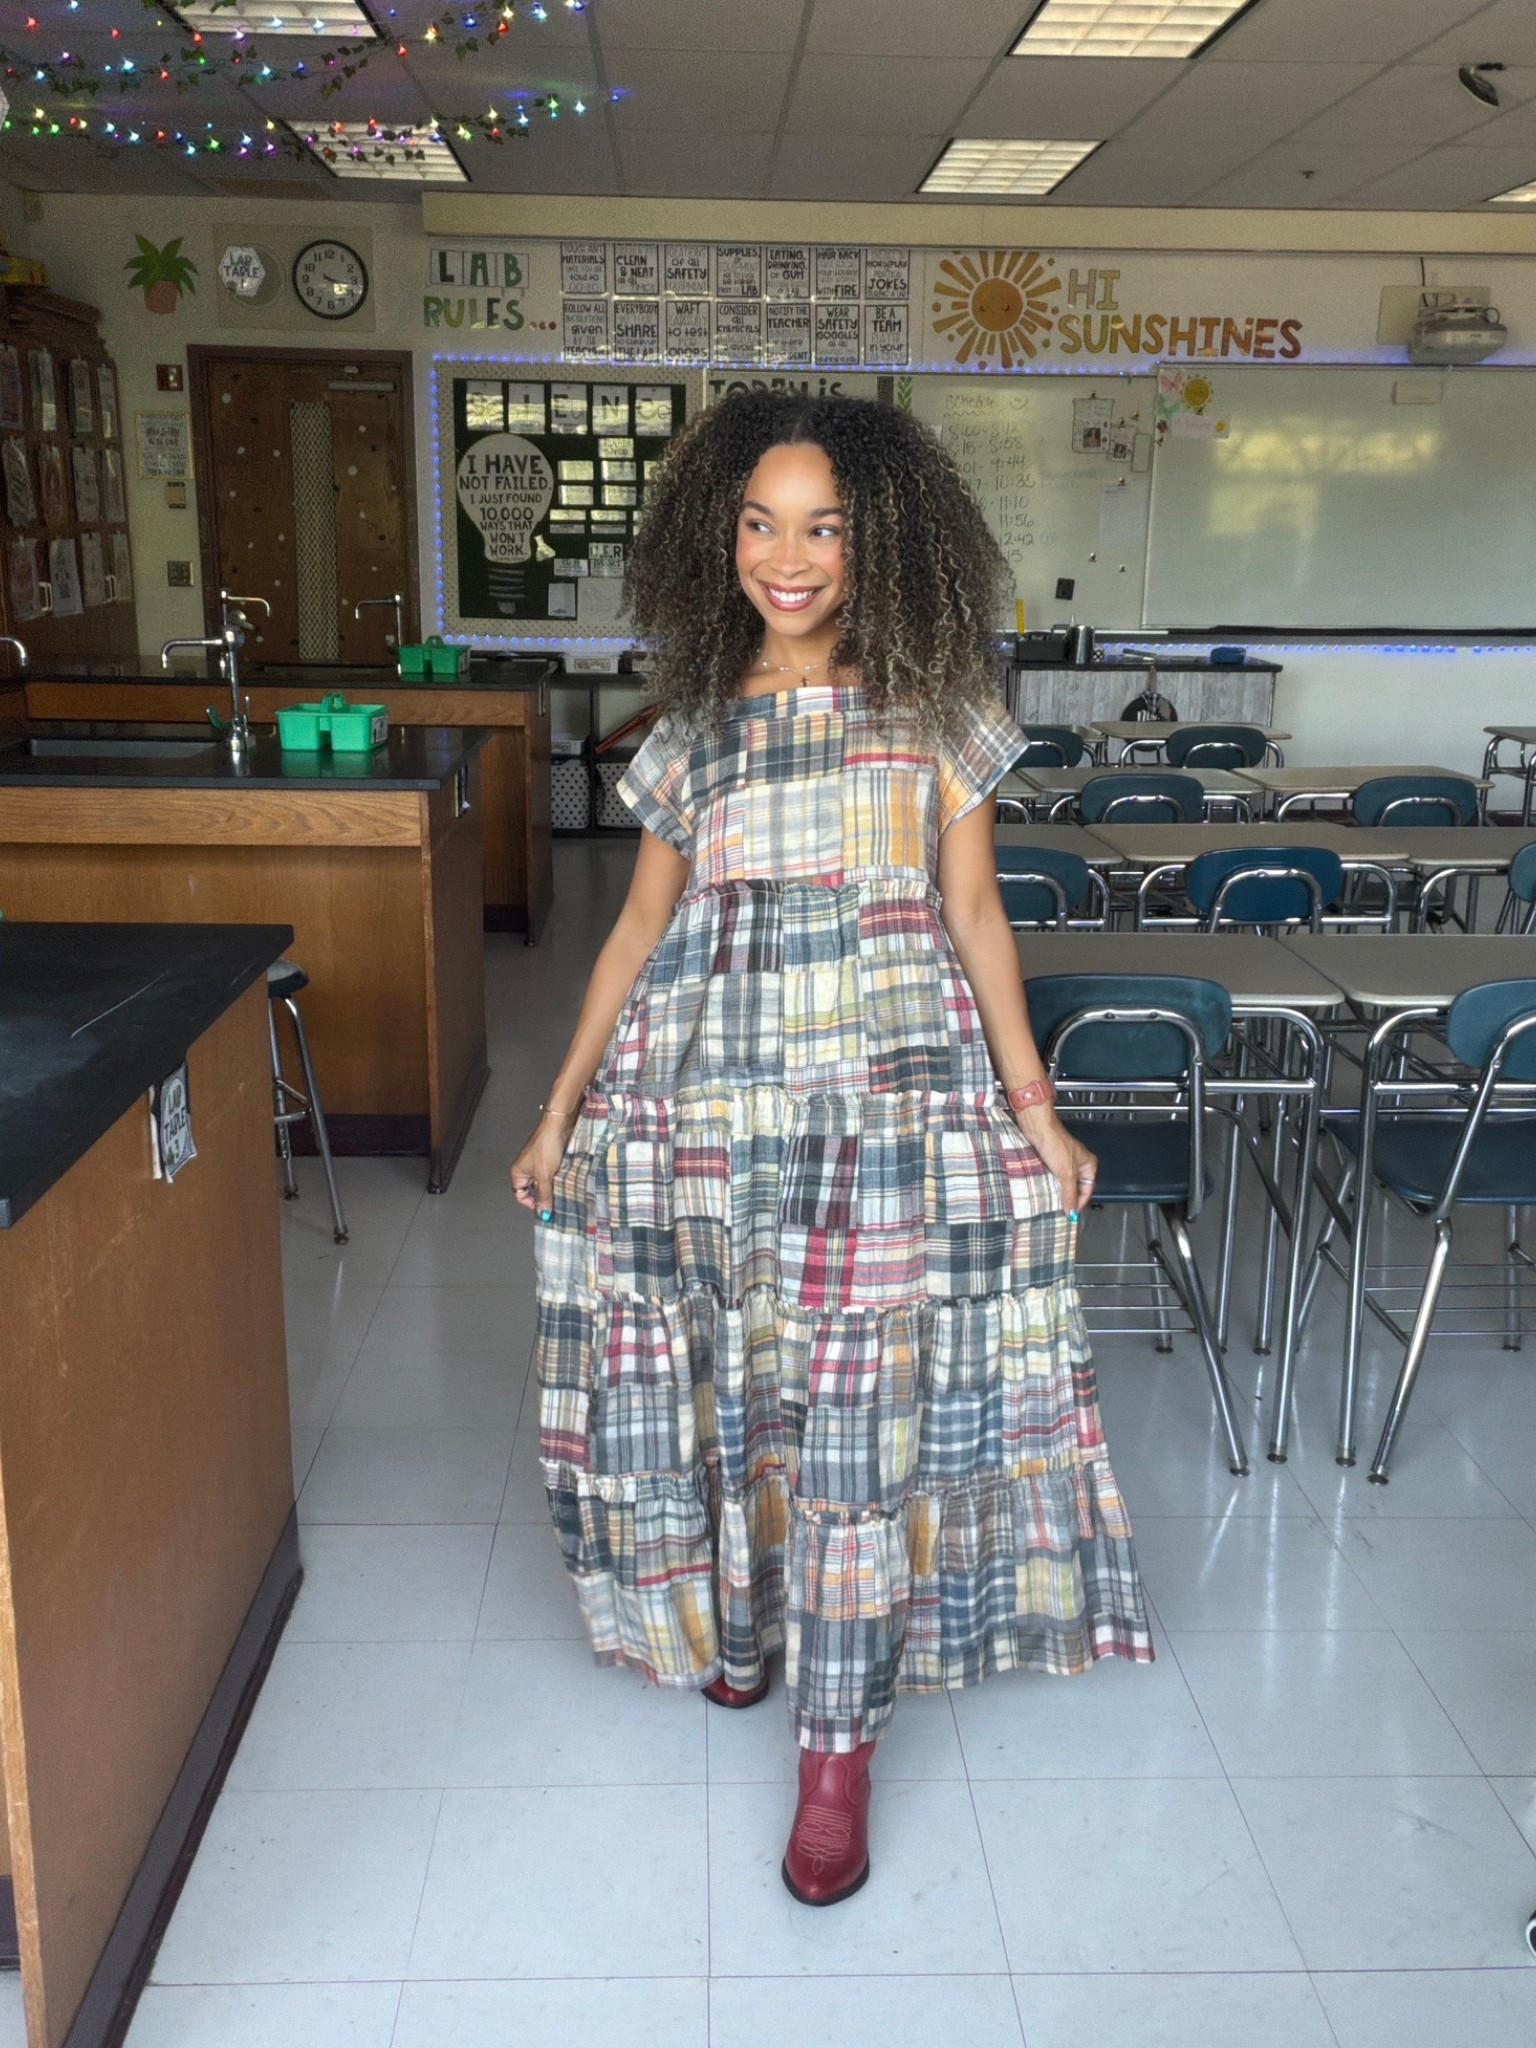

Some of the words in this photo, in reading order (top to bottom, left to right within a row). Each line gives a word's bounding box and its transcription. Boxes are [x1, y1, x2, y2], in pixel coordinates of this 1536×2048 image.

[230, 254, 252, 266] LAB
[314, 251, 322, 262] 11
[324, 249, 335, 260] 12
[562, 255, 605, 264] MATERIALS
[839, 251, 859, 259] BACK
[617, 256, 647, 265] CLEAN
[224, 265, 259, 278] TABLE
[304, 263, 315, 273] 10
[347, 264, 354, 274] 2
[438, 251, 522, 288] LAB
[631, 267, 654, 277] NEAT
[667, 268, 706, 279] SAFETY
[302, 274, 310, 284] 9
[351, 275, 358, 286] 3
[783, 271, 804, 279] GUM
[868, 278, 907, 290] JOKES
[1067, 268, 1121, 311] HI
[307, 287, 314, 297] 8
[742, 286, 758, 294] LAB
[834, 285, 856, 296] FIRE
[316, 297, 322, 306] 7
[328, 300, 335, 310] 6
[564, 304, 591, 313] FOLLOW
[594, 304, 606, 312] ALL
[615, 304, 658, 314] EVERYBODY
[675, 303, 701, 314] WAFT
[720, 305, 757, 315] CONSIDER
[769, 307, 793, 316] NOTIFY
[796, 307, 807, 315] THE
[827, 307, 849, 317] WEAR
[876, 307, 886, 319] BE
[889, 307, 895, 319] A
[768, 318, 810, 328] TEACHER
[818, 319, 857, 330] SAFETY
[873, 320, 901, 332] TEAM
[572, 325, 602, 334] given
[617, 324, 657, 337] SHARE
[669, 328, 681, 336] to
[685, 328, 707, 336] test
[816, 331, 858, 339] GOGGLES
[1058, 313, 1303, 359] SUNSHINES
[467, 454, 476, 475] I
[485, 454, 544, 475] HAVE
[990, 455, 1025, 474] 9:44
[459, 476, 489, 490] NOT
[495, 476, 553, 491] FAILED.
[995, 473, 1035, 491] 10:35
[470, 493, 475, 504] I
[479, 493, 504, 504] JUST
[505, 492, 543, 504] FOUND
[1000, 495, 1029, 511] 11:10
[480, 507, 534, 521] 10,000
[480, 521, 506, 531] WAYS
[509, 521, 534, 531] THAT
[1000, 513, 1034, 528] 11:56
[490, 532, 526, 543] WON'T
[489, 544, 528, 556] WORK.
[164, 1106, 186, 1145] TABLE
